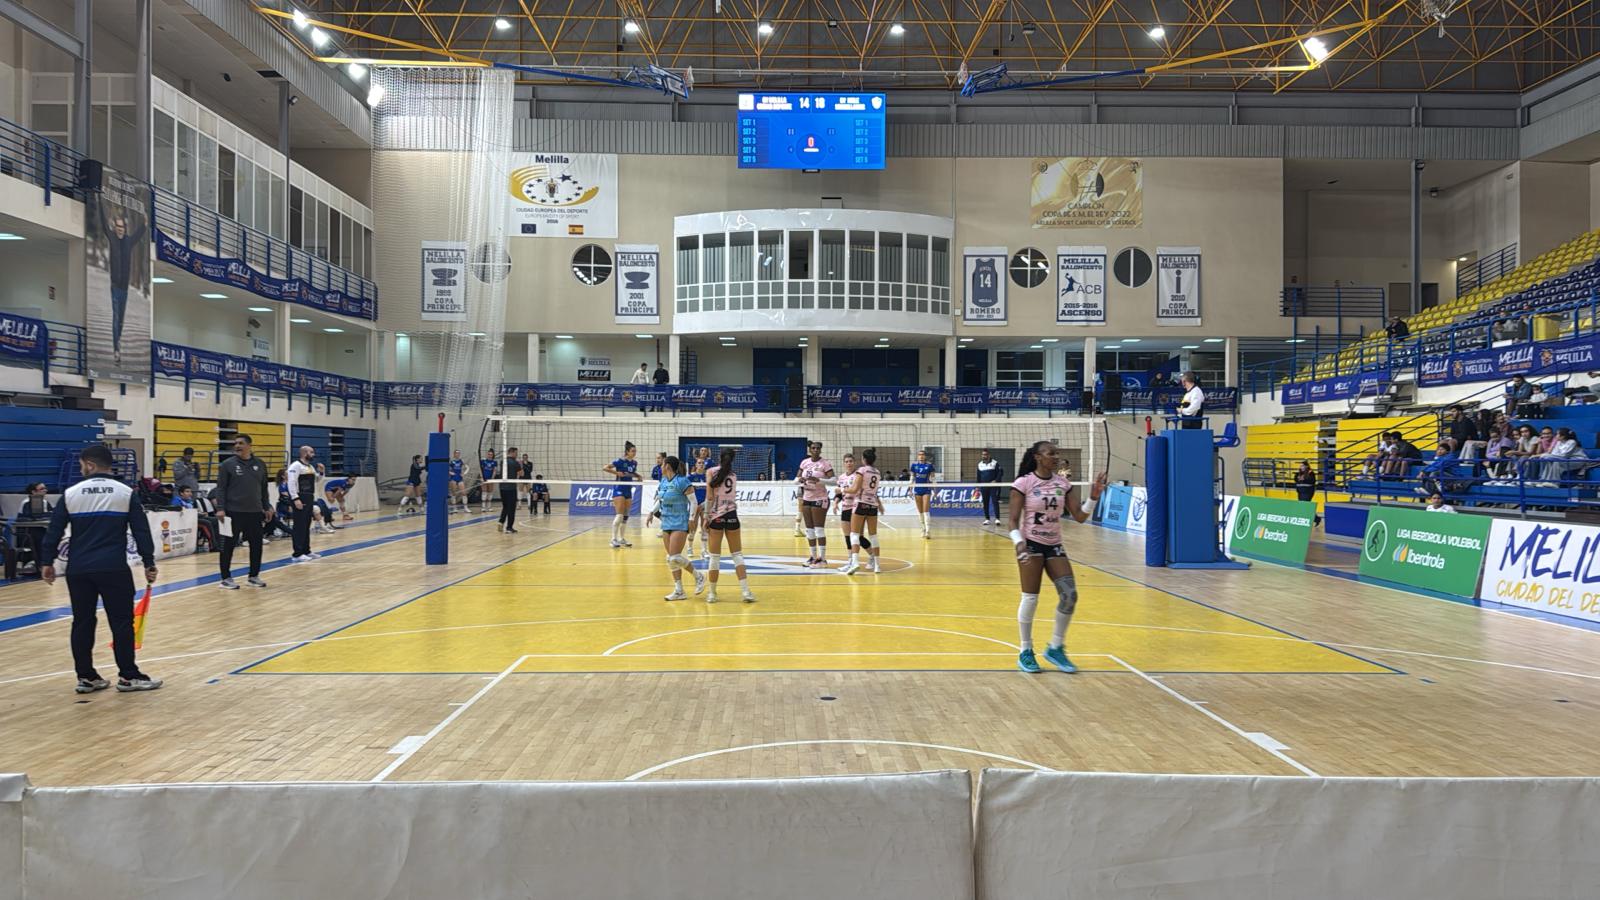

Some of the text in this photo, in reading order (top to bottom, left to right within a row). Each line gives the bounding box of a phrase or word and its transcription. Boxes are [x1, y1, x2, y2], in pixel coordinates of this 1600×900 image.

[799, 97, 810, 109] 14
[807, 136, 815, 148] 0
[535, 154, 569, 164] Melilla
[1111, 210, 1131, 218] 2022
[979, 273, 992, 288] 14
[1076, 284, 1102, 294] ACB
[629, 292, 644, 300] 2001
[969, 307, 1001, 315] ROMERO
[1498, 346, 1534, 366] MELILLA
[1421, 359, 1449, 374] MELILLA
[1465, 363, 1493, 375] MELILLA
[580, 370, 609, 378] MELILLA
[579, 387, 615, 397] MELILLA
[672, 389, 707, 399] MELILLA
[808, 388, 842, 398] MELILLA
[898, 390, 933, 399] MELILLA
[988, 390, 1023, 400] MELILLA
[1121, 391, 1153, 400] MELILLA
[635, 394, 666, 402] MELILLA
[727, 395, 758, 403] MELILLA
[862, 395, 892, 403] MELILLA
[952, 396, 983, 404] MELILLA
[724, 478, 733, 494] 9
[869, 475, 877, 489] 8
[81, 486, 114, 495] FMLVB
[1042, 496, 1058, 510] 14
[1396, 528, 1482, 550] LIGA IBERDROLA VOLEIBOL
[1496, 578, 1545, 603] CIUDAD
[1548, 587, 1574, 609] DEL
